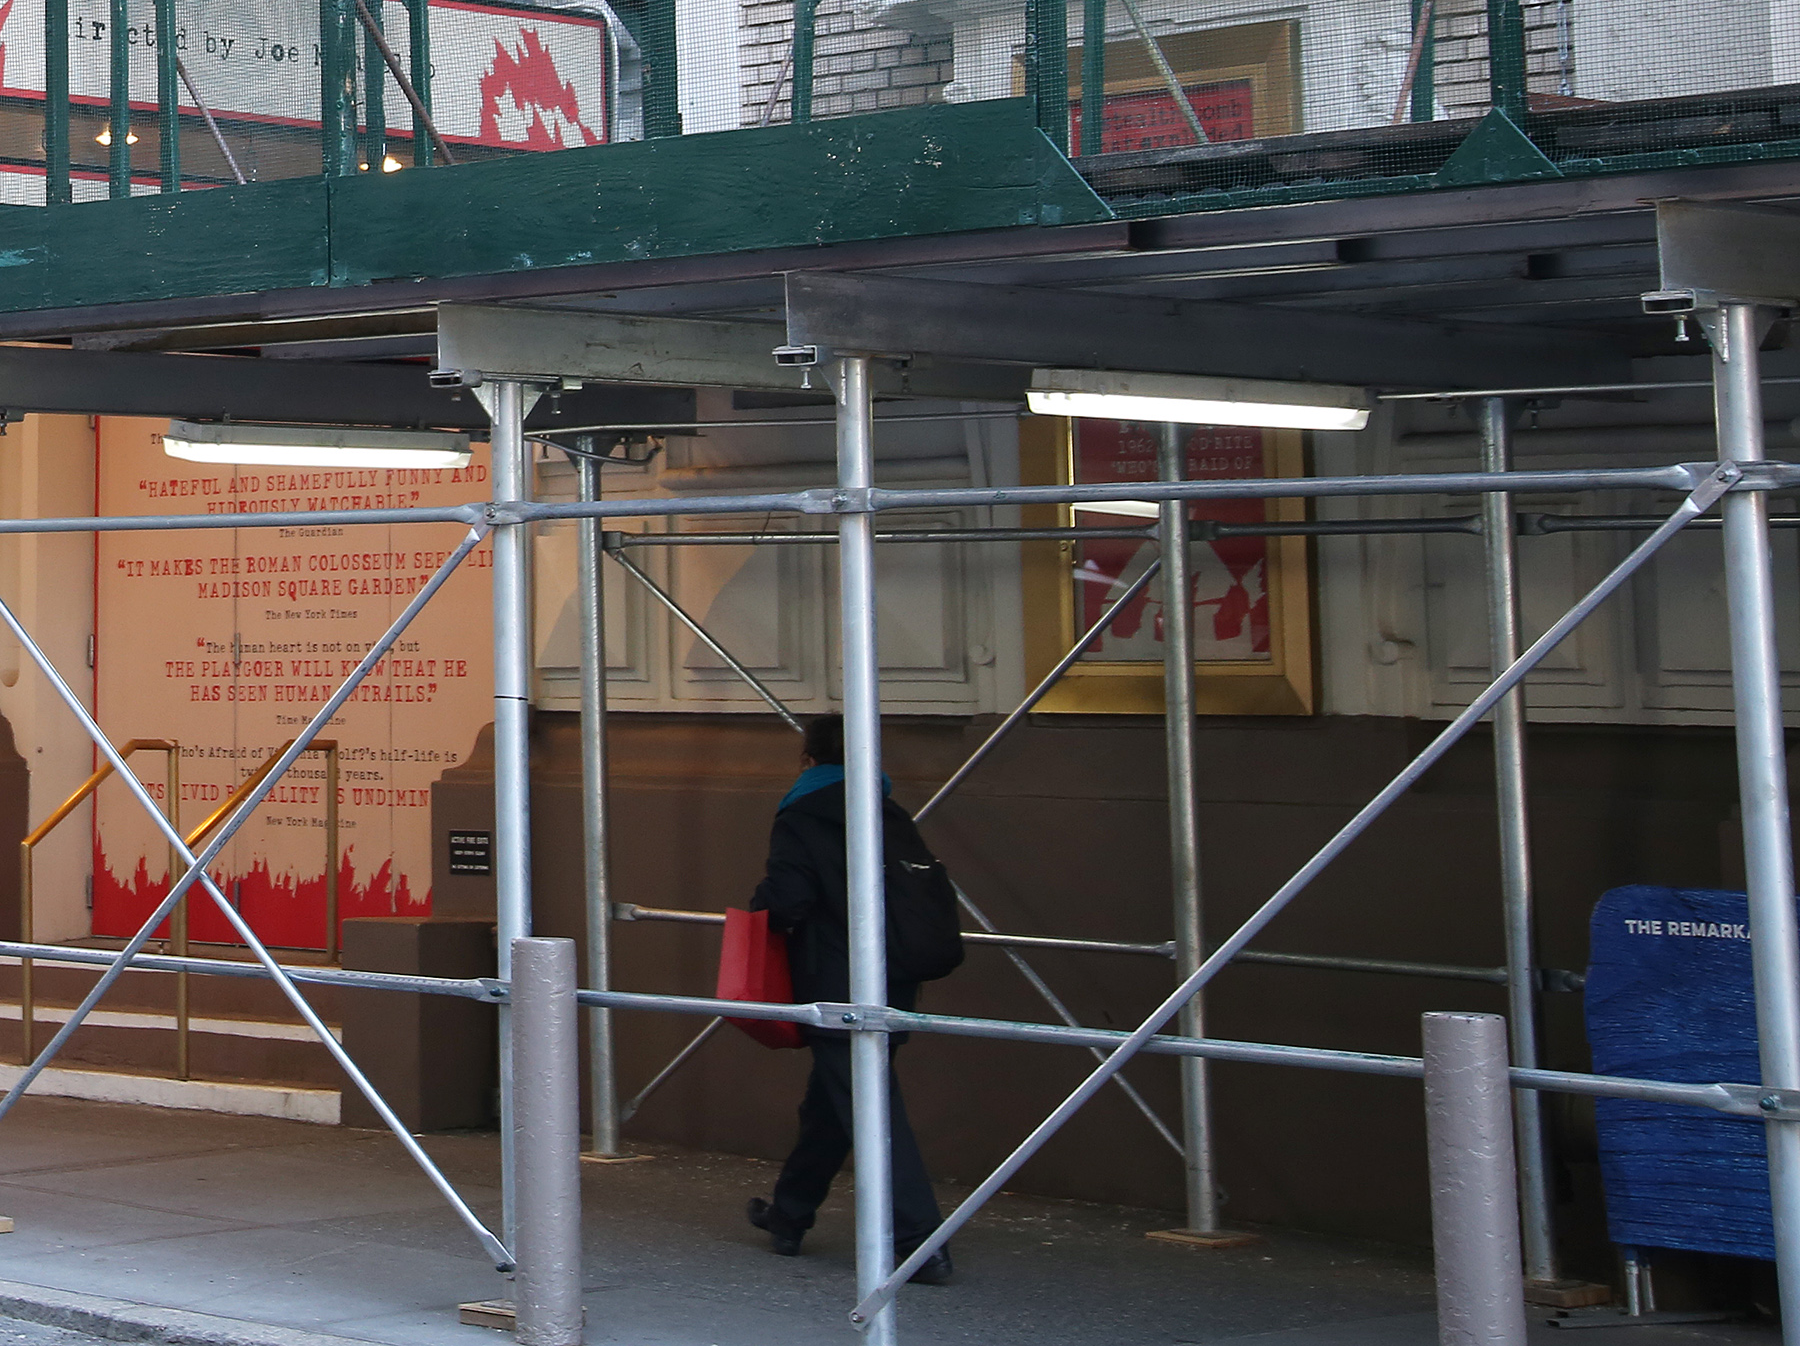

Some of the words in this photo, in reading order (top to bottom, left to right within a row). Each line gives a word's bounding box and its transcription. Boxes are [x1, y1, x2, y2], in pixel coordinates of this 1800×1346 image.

[205, 30, 234, 58] by
[255, 36, 299, 63] Joe
[139, 478, 221, 497] "HATEFUL
[228, 476, 260, 493] AND
[266, 469, 378, 492] SHAMEFULLY
[385, 468, 445, 486] FUNNY
[451, 465, 487, 484] AND
[280, 529, 296, 537] The
[300, 527, 344, 537] Guardian
[118, 559, 144, 577] "IT
[151, 559, 203, 576] MAKES
[210, 558, 240, 574] THE
[246, 556, 302, 574] ROMAN
[309, 552, 406, 571] COLOSSEUM
[414, 551, 452, 569] SEE
[198, 581, 271, 599] MADISON
[278, 579, 342, 601] SQUARE
[266, 610, 282, 620] The
[285, 610, 301, 619] New
[305, 609, 326, 619] York
[330, 609, 358, 619] Times
[197, 638, 226, 653] "The
[270, 641, 302, 653] heart
[306, 642, 318, 653] is
[322, 641, 342, 652] not
[347, 643, 360, 652] on
[400, 641, 420, 652] but
[166, 661, 195, 677] THE
[201, 661, 284, 677] PLAYGOER
[291, 660, 334, 677] WILL
[392, 660, 436, 677] THAT
[444, 660, 467, 677] HE
[190, 685, 221, 702] HAS
[228, 685, 268, 702] SEEN
[275, 685, 331, 702] HUMAN
[345, 683, 437, 702] NTRAILS."
[276, 715, 298, 725] Time
[208, 747, 246, 758] Afraid
[252, 747, 264, 758] of
[381, 749, 440, 762] half-life
[445, 751, 457, 762] is
[345, 770, 384, 782] years.
[266, 816, 282, 825] New
[287, 816, 308, 826] York
[1625, 920, 1662, 934] THE
[1668, 922, 1751, 938] REMARK
